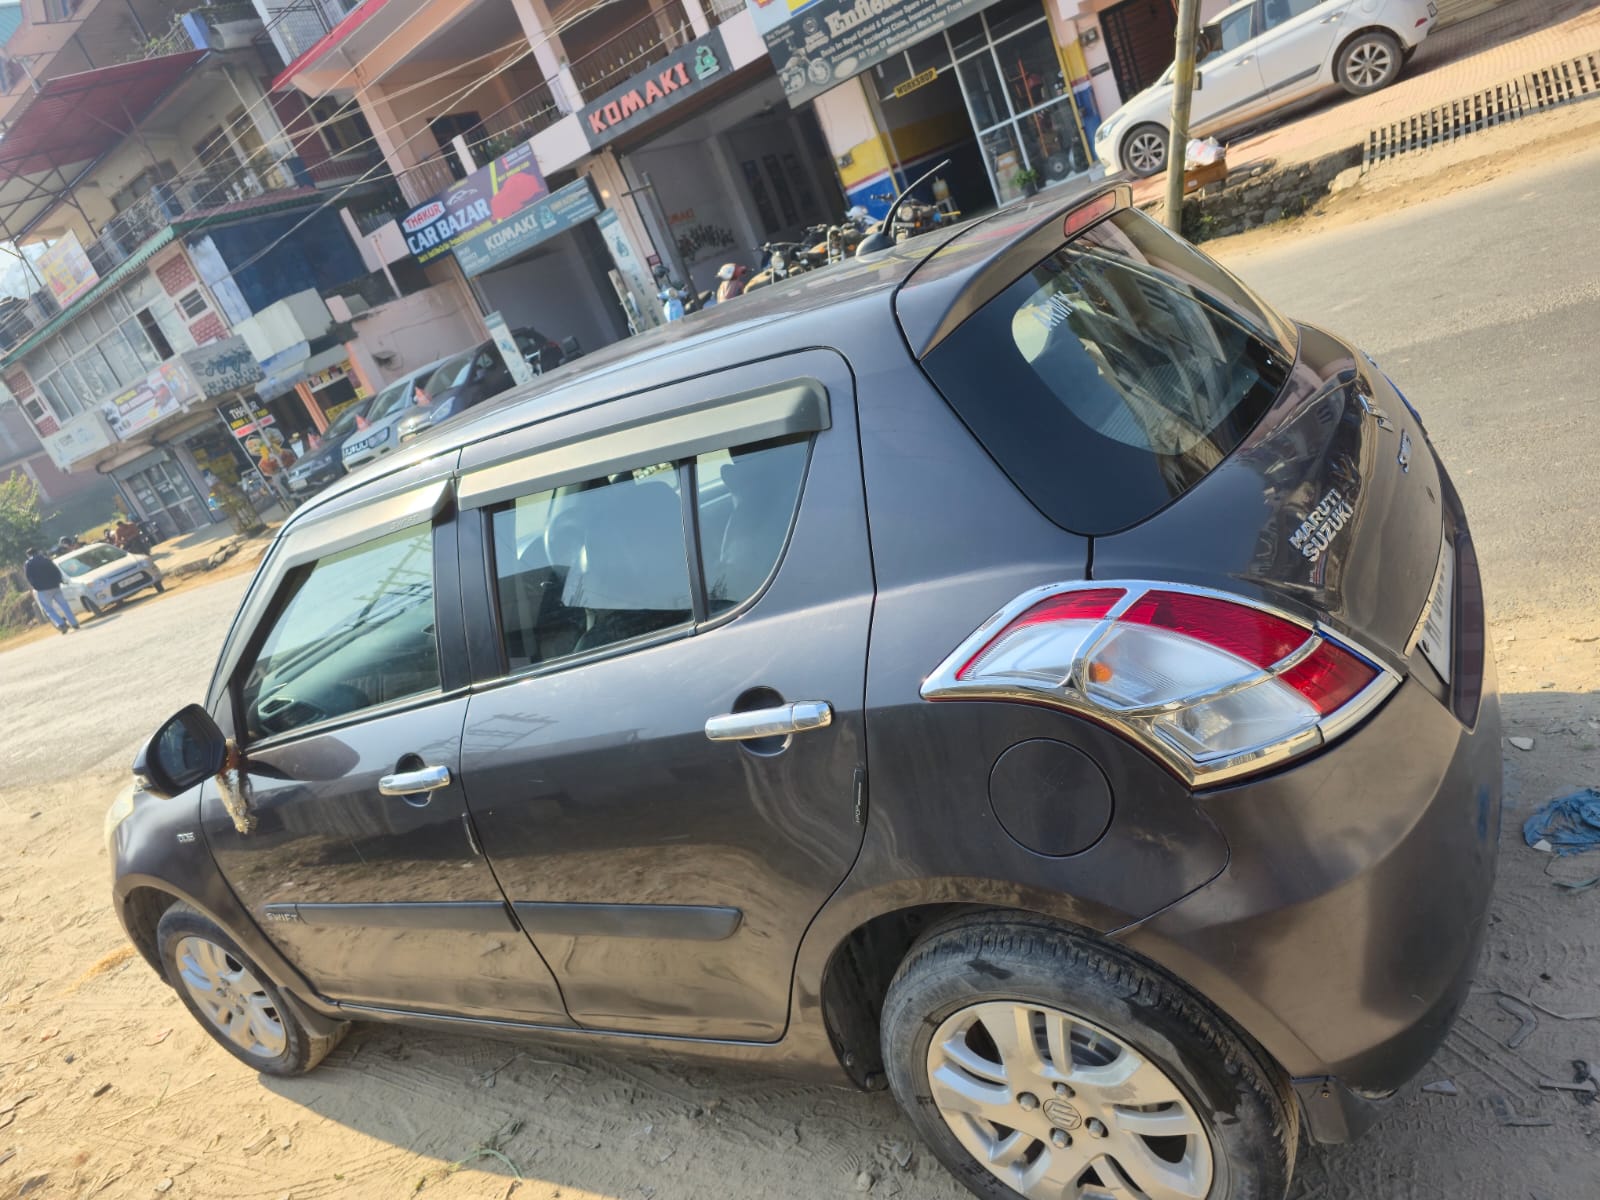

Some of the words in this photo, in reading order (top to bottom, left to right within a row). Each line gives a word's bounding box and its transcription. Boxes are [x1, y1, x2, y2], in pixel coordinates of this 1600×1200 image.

[863, 26, 892, 46] Accidental
[588, 62, 690, 134] KOMAKI
[895, 69, 934, 95] WORKSHOP
[406, 203, 442, 230] THAKUR
[407, 225, 440, 255] CAR
[435, 198, 491, 240] BAZAR
[485, 213, 538, 251] KOMAKI
[1289, 488, 1342, 549] MARUTI
[1302, 502, 1354, 562] SUZUKI
[265, 911, 298, 923] SWIFT
